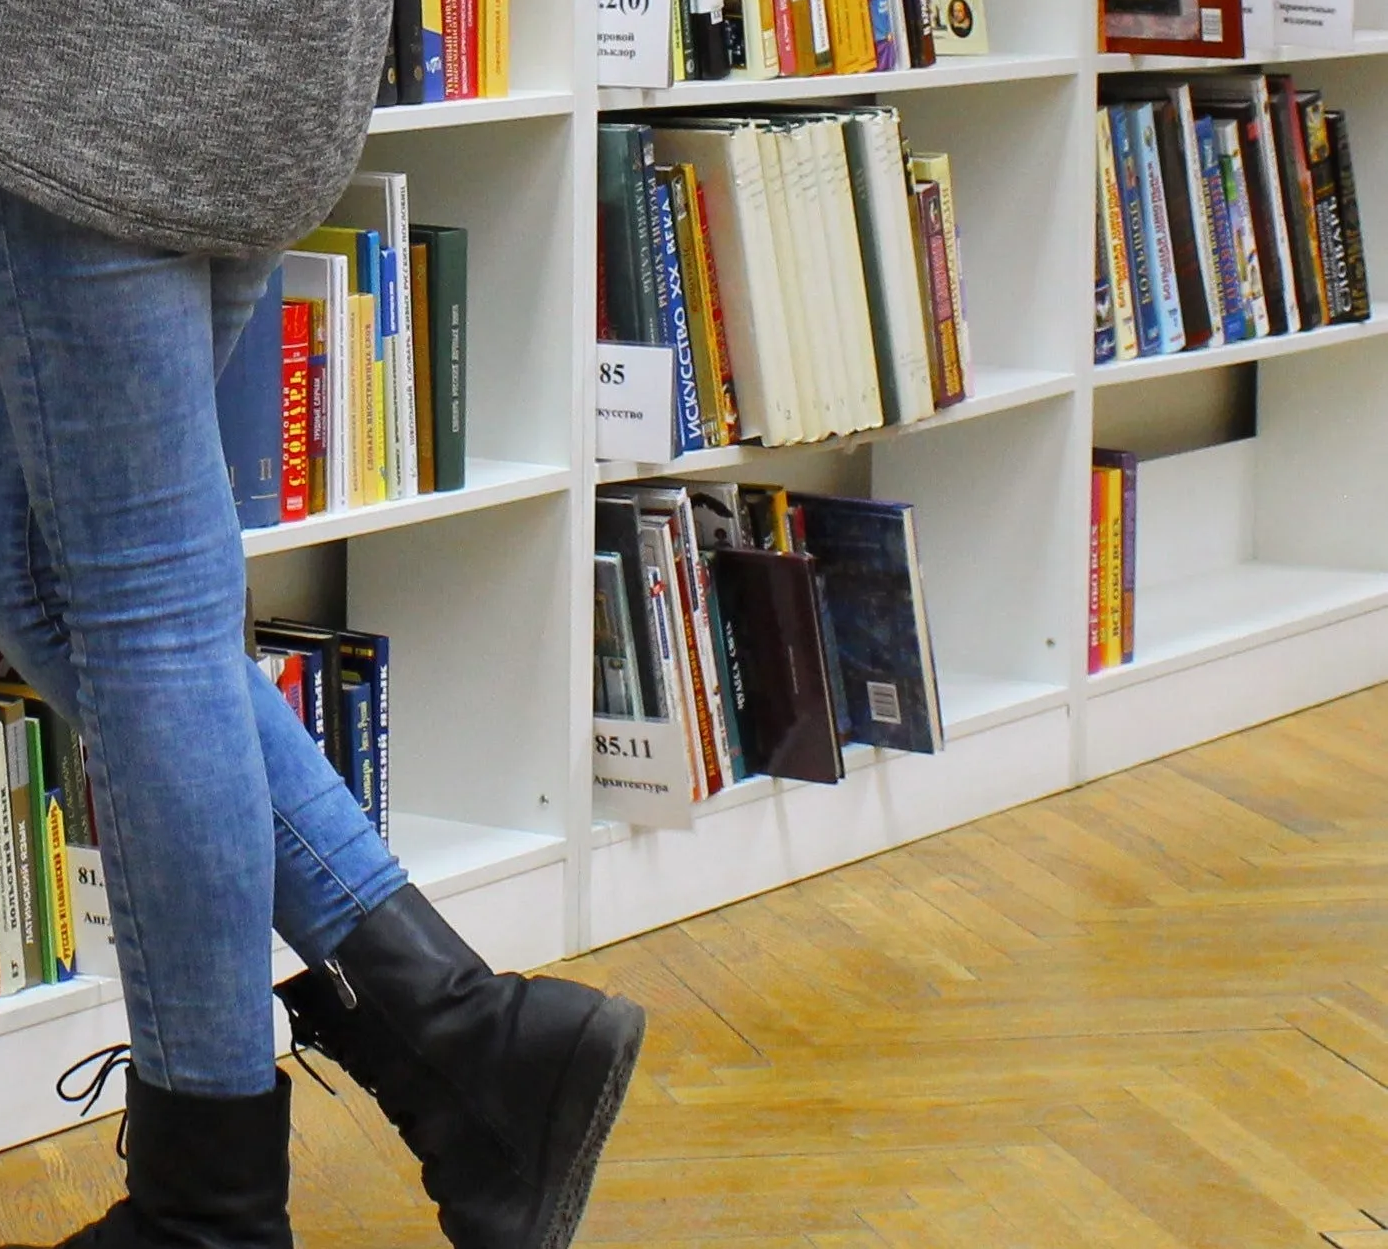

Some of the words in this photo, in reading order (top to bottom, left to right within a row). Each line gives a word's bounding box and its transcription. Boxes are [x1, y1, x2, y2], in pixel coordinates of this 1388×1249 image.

[597, 30, 634, 42] ровой
[597, 46, 636, 59] льклор
[659, 198, 677, 254] ВЕКА
[599, 363, 625, 385] 85
[673, 305, 701, 438] ИСКУССТВО
[596, 409, 644, 422] кусство
[289, 370, 302, 486] СЛОВАРЬ
[595, 734, 652, 760] 85.11
[592, 773, 669, 794] Архитектура
[77, 868, 104, 888] 81.
[84, 911, 110, 924] Анг
